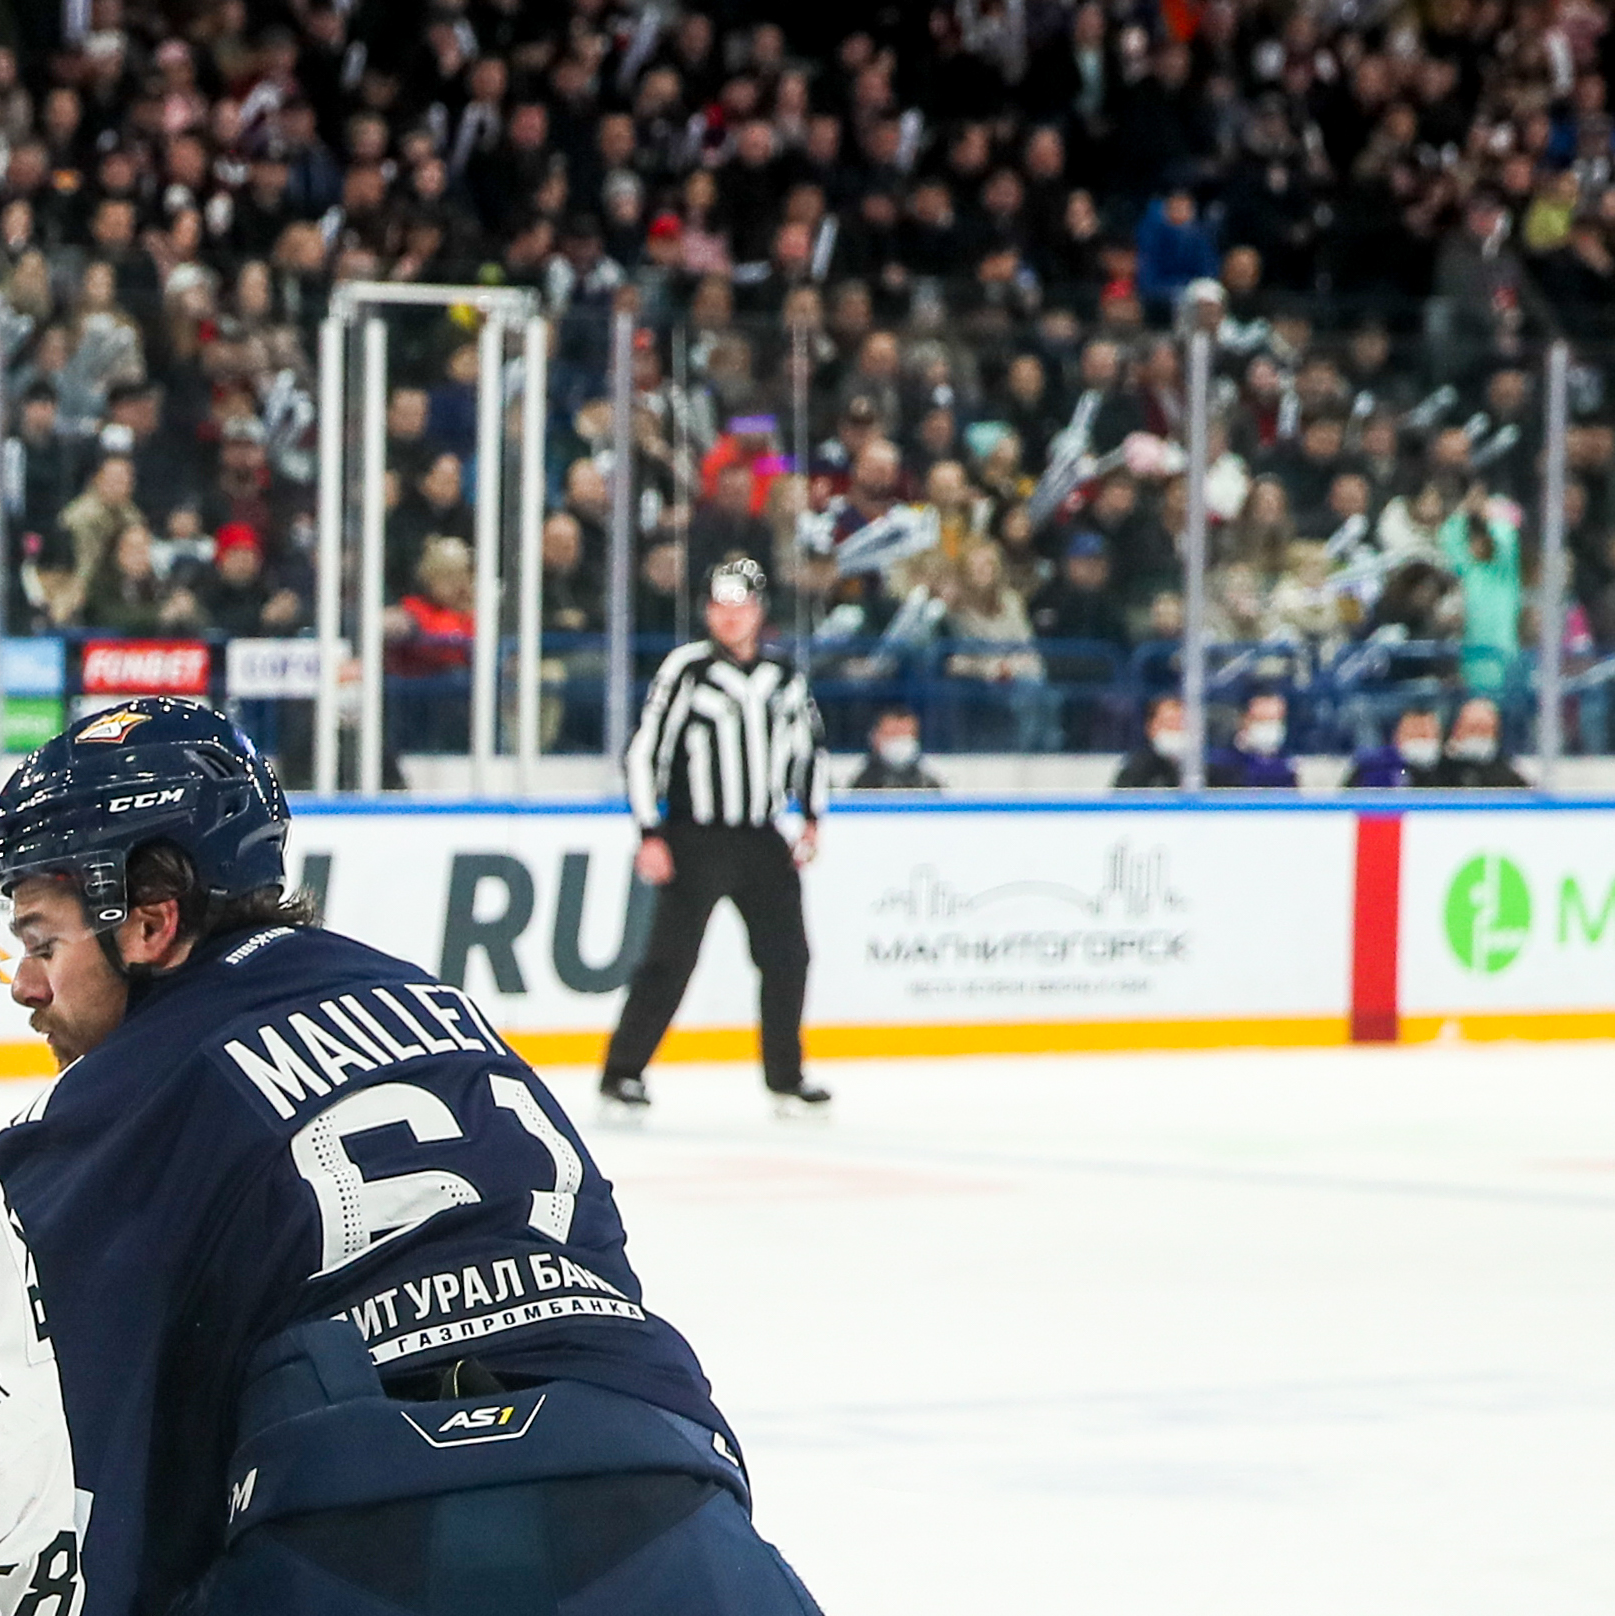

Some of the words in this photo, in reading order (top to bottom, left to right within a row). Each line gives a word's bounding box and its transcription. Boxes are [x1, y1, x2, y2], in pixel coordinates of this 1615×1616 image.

[107, 787, 185, 814] CCM
[223, 983, 507, 1121] MAILLET
[291, 1073, 584, 1280] 61
[403, 1258, 525, 1320] УРАЛ
[398, 1300, 639, 1352] ГАЗПРОМБАНКА
